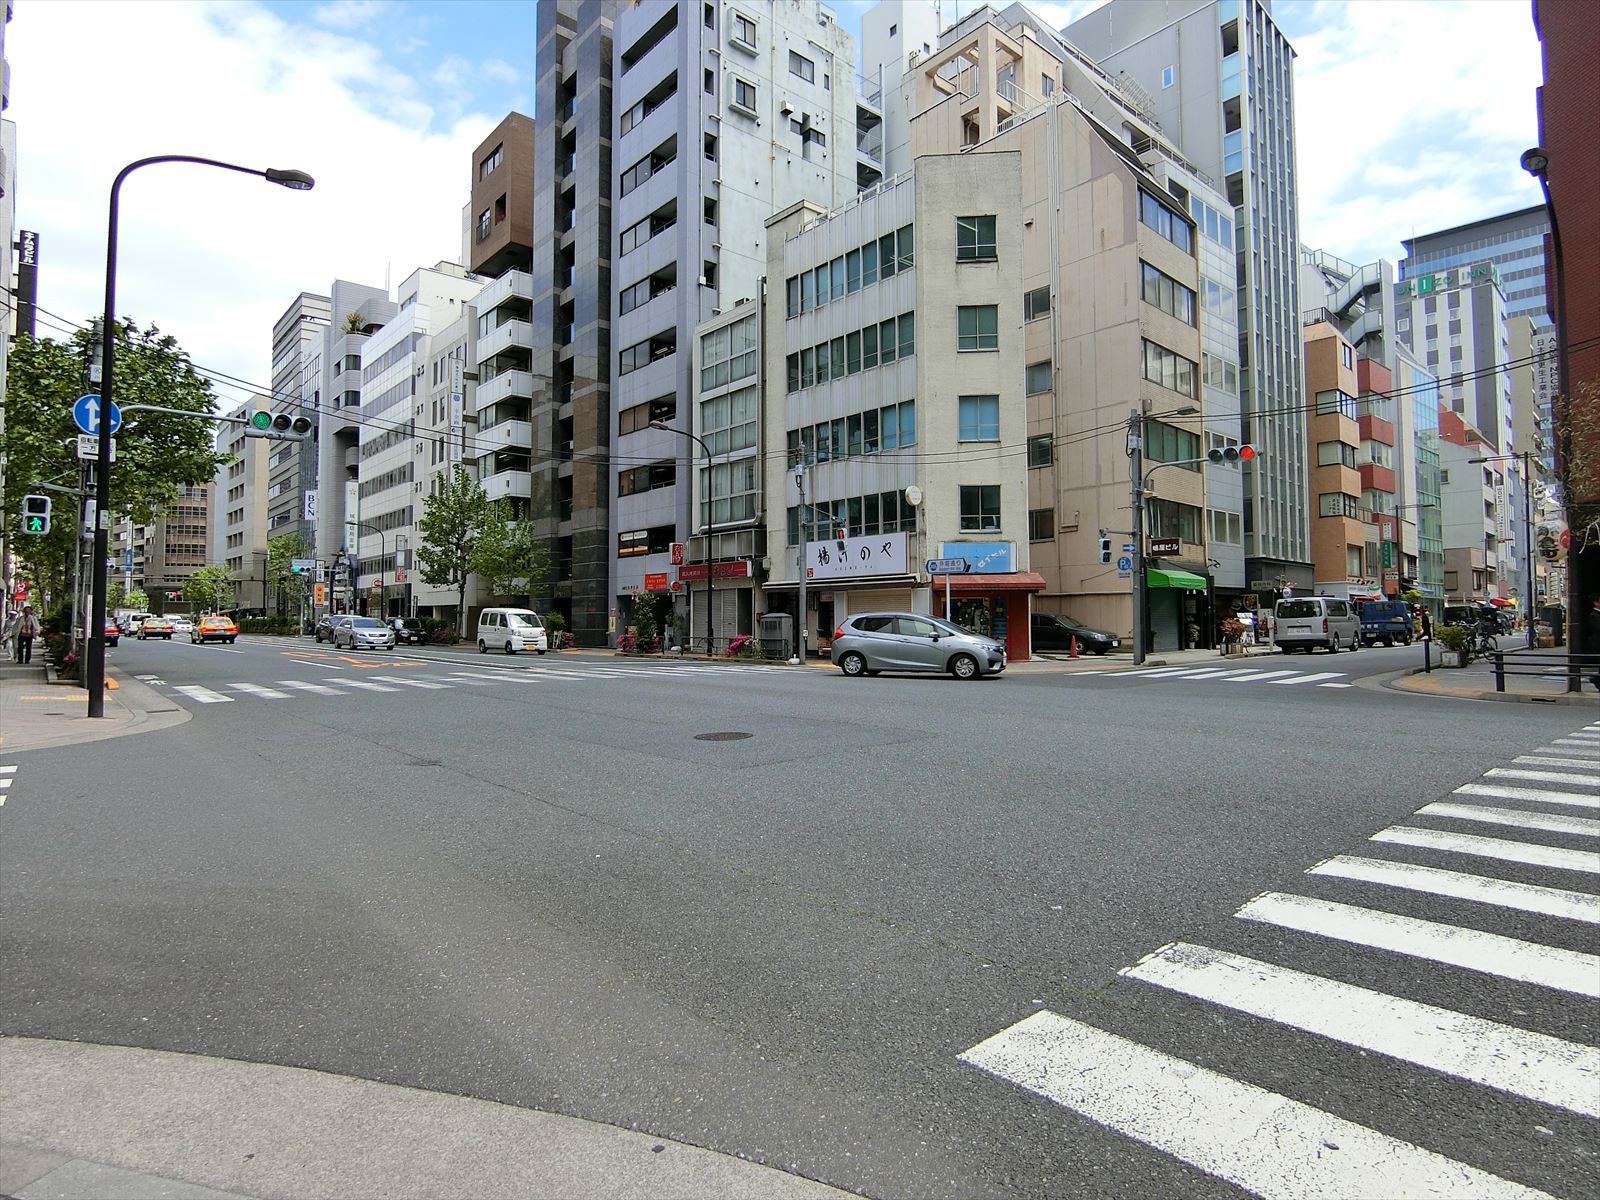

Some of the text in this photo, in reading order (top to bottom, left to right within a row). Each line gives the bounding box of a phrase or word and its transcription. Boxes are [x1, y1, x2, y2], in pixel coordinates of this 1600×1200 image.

[24, 232, 35, 264] キムラビル
